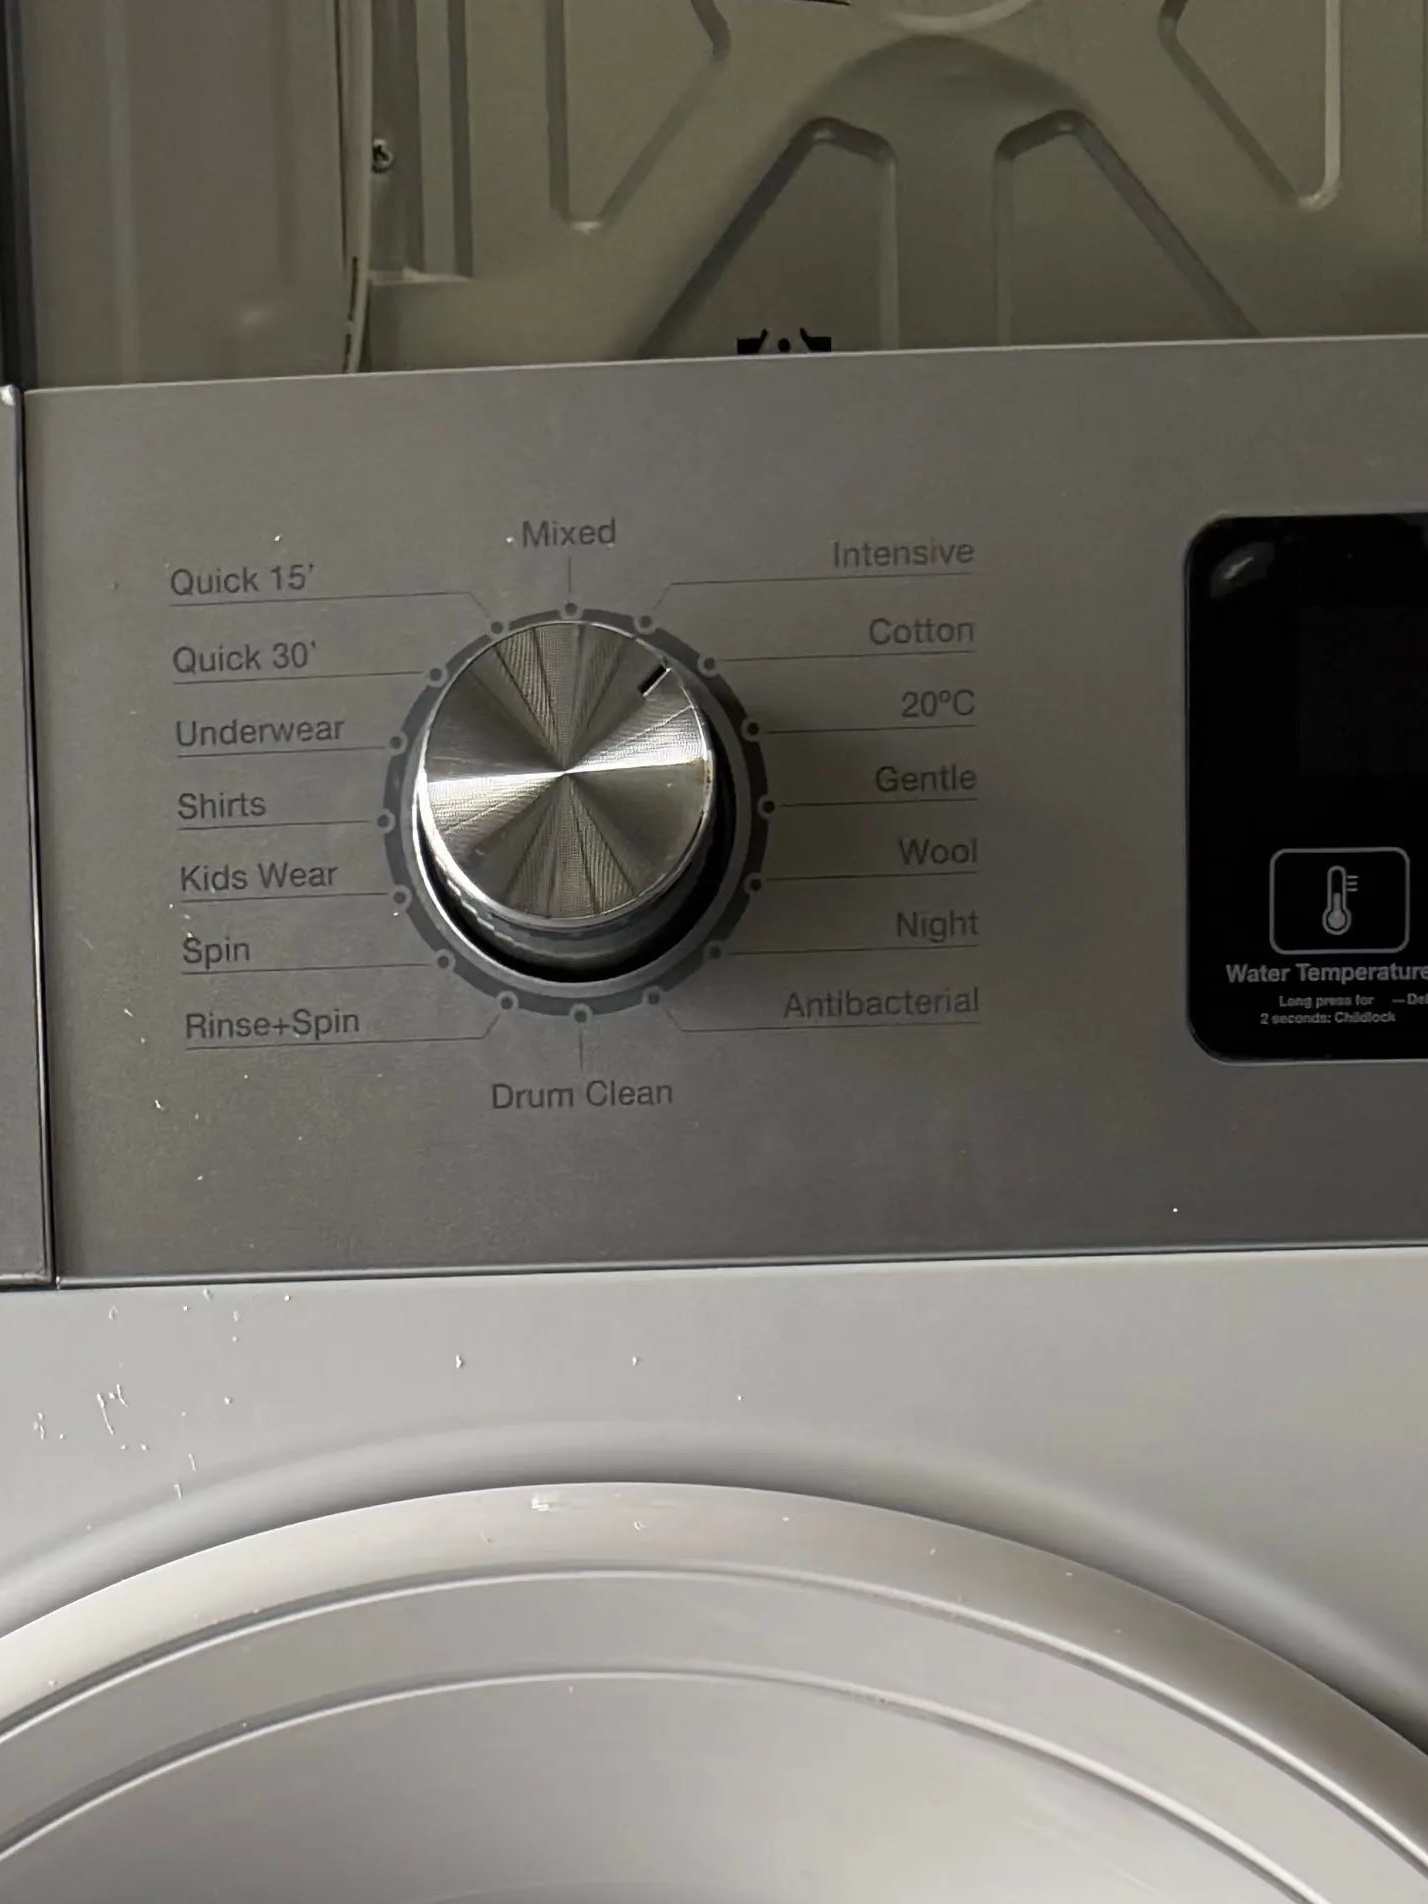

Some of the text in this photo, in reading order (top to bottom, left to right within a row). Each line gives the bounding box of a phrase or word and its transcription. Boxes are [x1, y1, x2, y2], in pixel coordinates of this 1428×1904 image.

[523, 517, 615, 548] Mixed
[834, 538, 975, 568] Intensive
[171, 563, 314, 596] Quick 15'
[869, 618, 974, 646] Cotton
[173, 641, 316, 674] Quick 30'
[176, 719, 345, 747] Underwear
[870, 765, 975, 793] Gentle
[178, 792, 266, 820] Shirts
[897, 837, 977, 865] Wool
[181, 861, 338, 894] Kids Wear
[897, 910, 978, 944] Night
[183, 932, 249, 970] Spin
[1226, 964, 1291, 983] Water
[784, 986, 978, 1022] Antibacterial
[1279, 994, 1375, 1009] Long press for
[186, 1008, 359, 1041] Rinse+Spin
[1260, 1013, 1269, 1024] 2
[492, 1080, 673, 1109] Drum Clean
